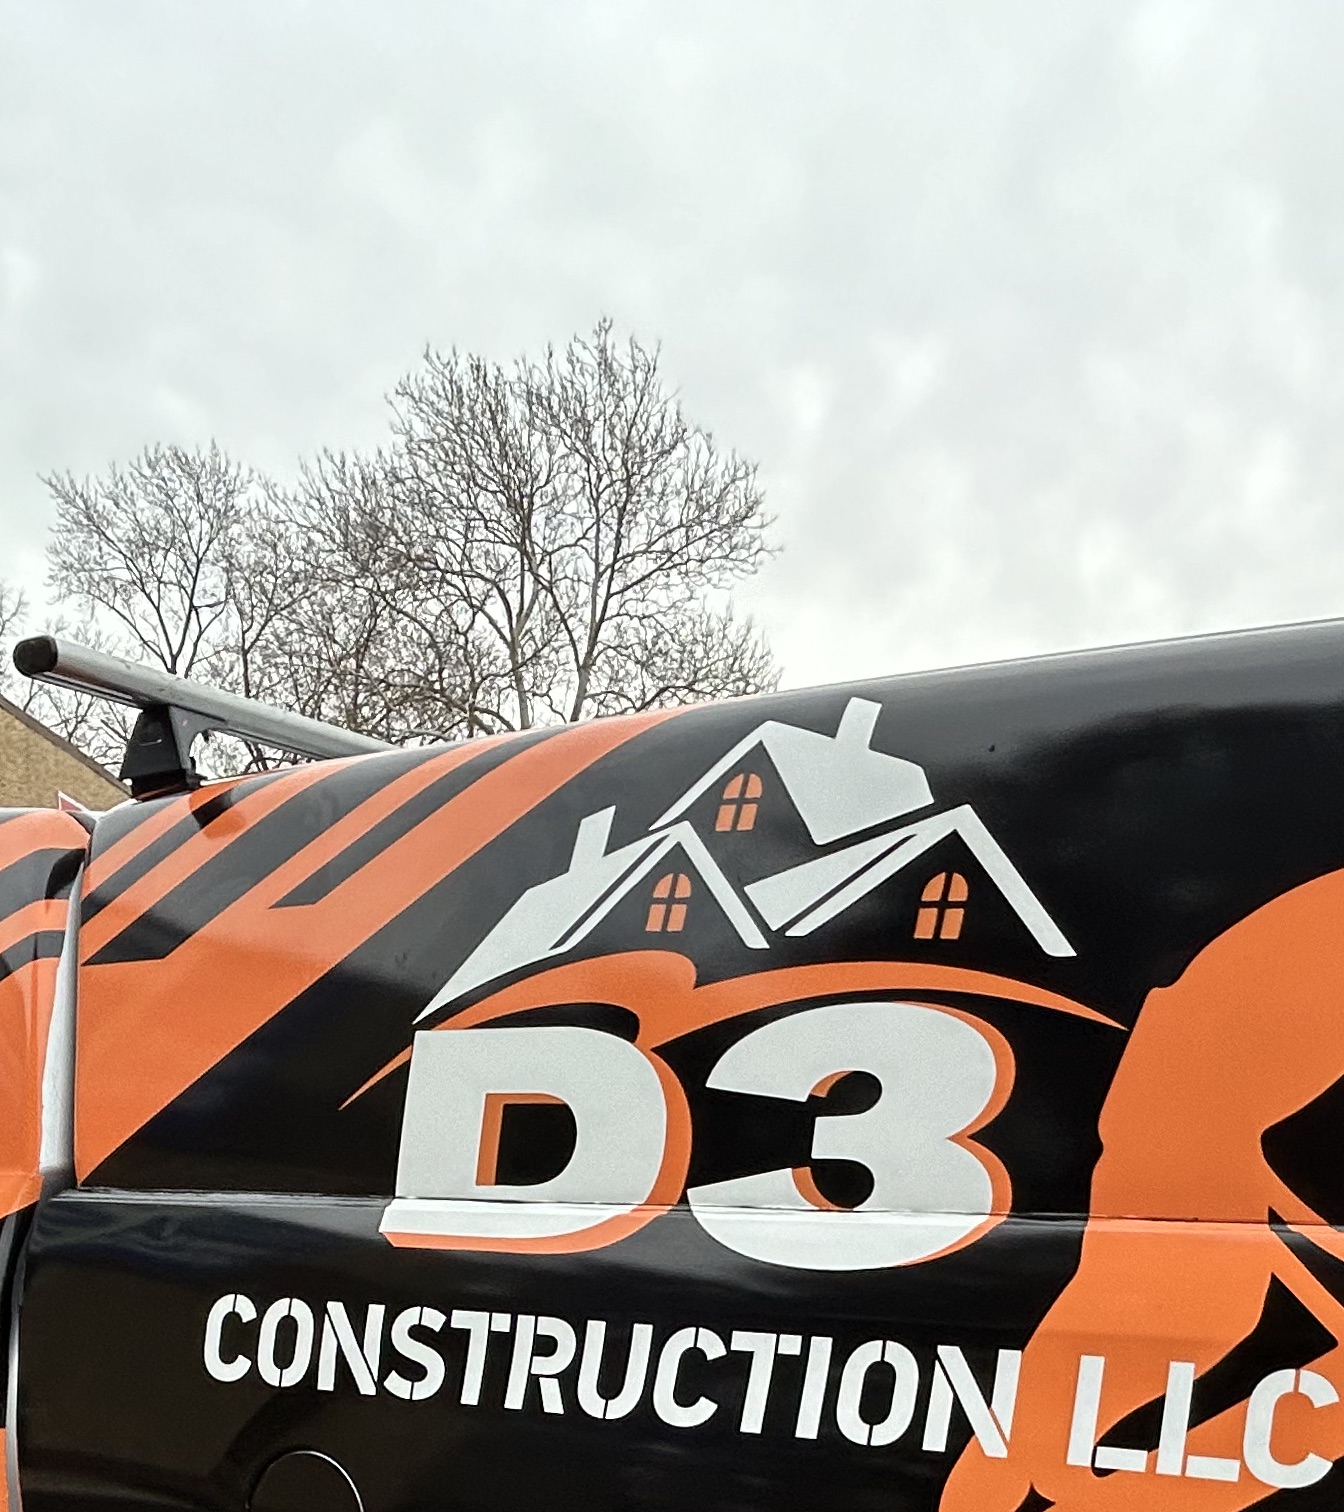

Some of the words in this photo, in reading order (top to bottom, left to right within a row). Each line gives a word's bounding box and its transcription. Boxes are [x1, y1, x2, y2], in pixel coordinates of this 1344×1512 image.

[379, 1001, 1016, 1271] D3
[202, 1291, 1022, 1459] CONSTRUCTION
[1066, 1353, 1341, 1490] LLC
